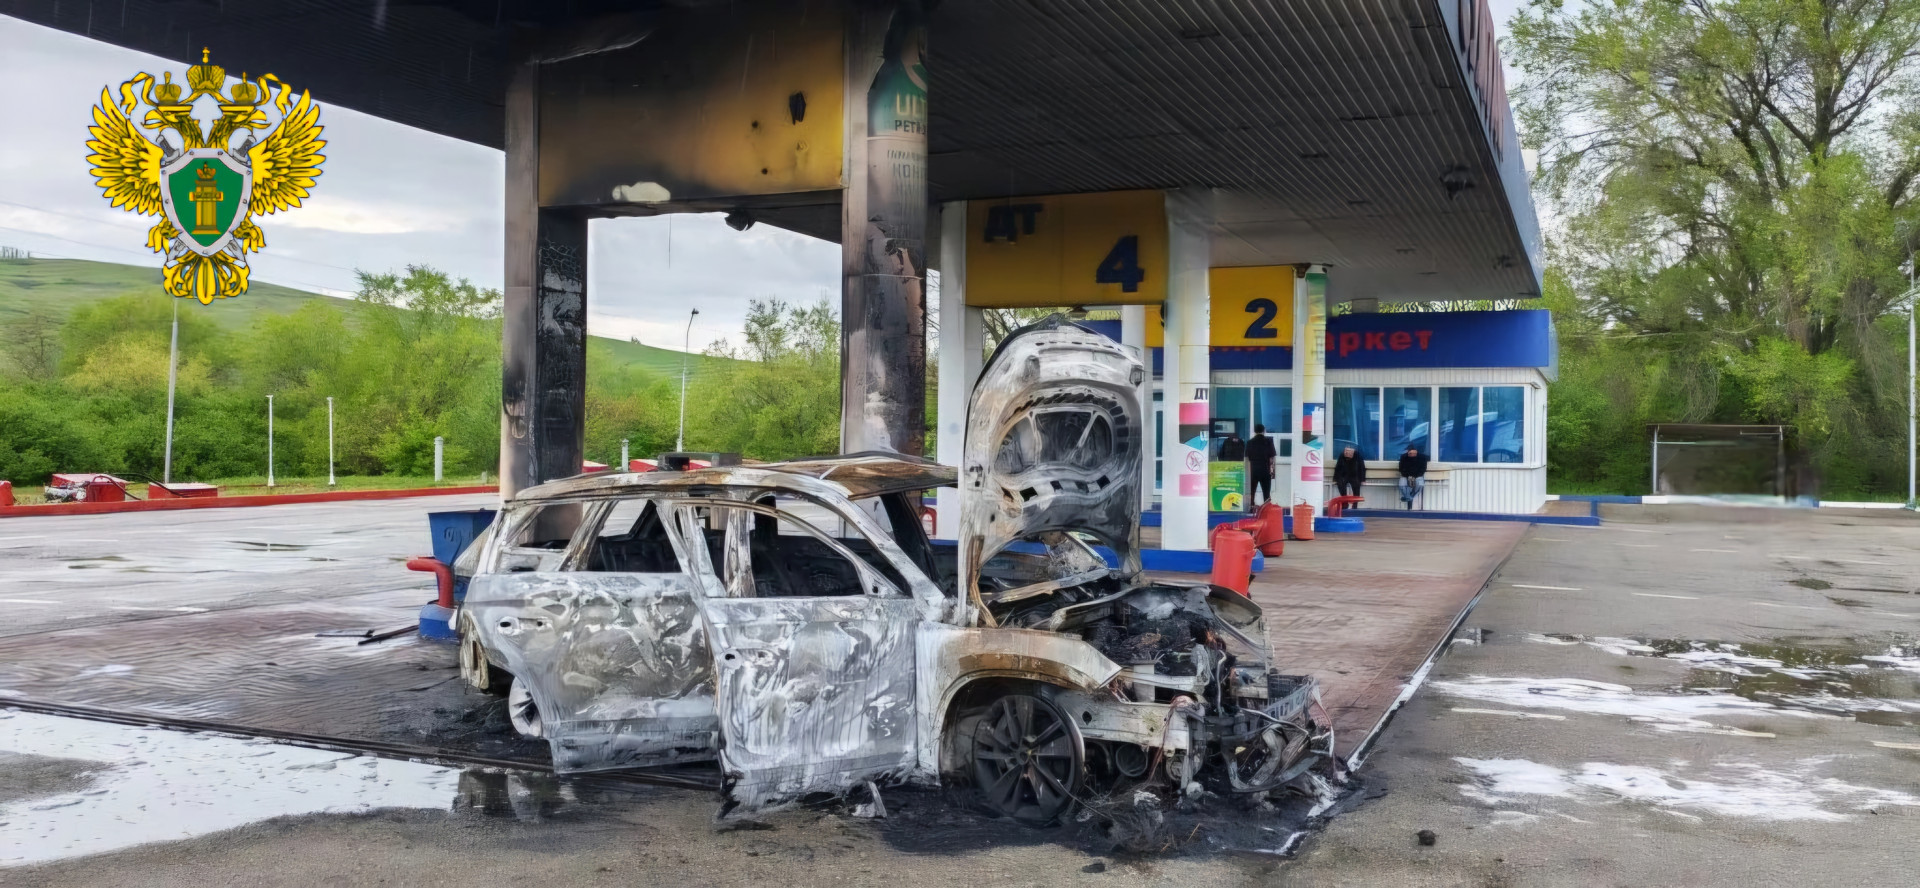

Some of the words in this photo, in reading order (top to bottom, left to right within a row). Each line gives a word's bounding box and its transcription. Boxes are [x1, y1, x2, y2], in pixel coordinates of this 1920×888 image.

[984, 204, 1043, 243] ДТ
[1096, 235, 1144, 292] 4
[1244, 298, 1277, 338] 2
